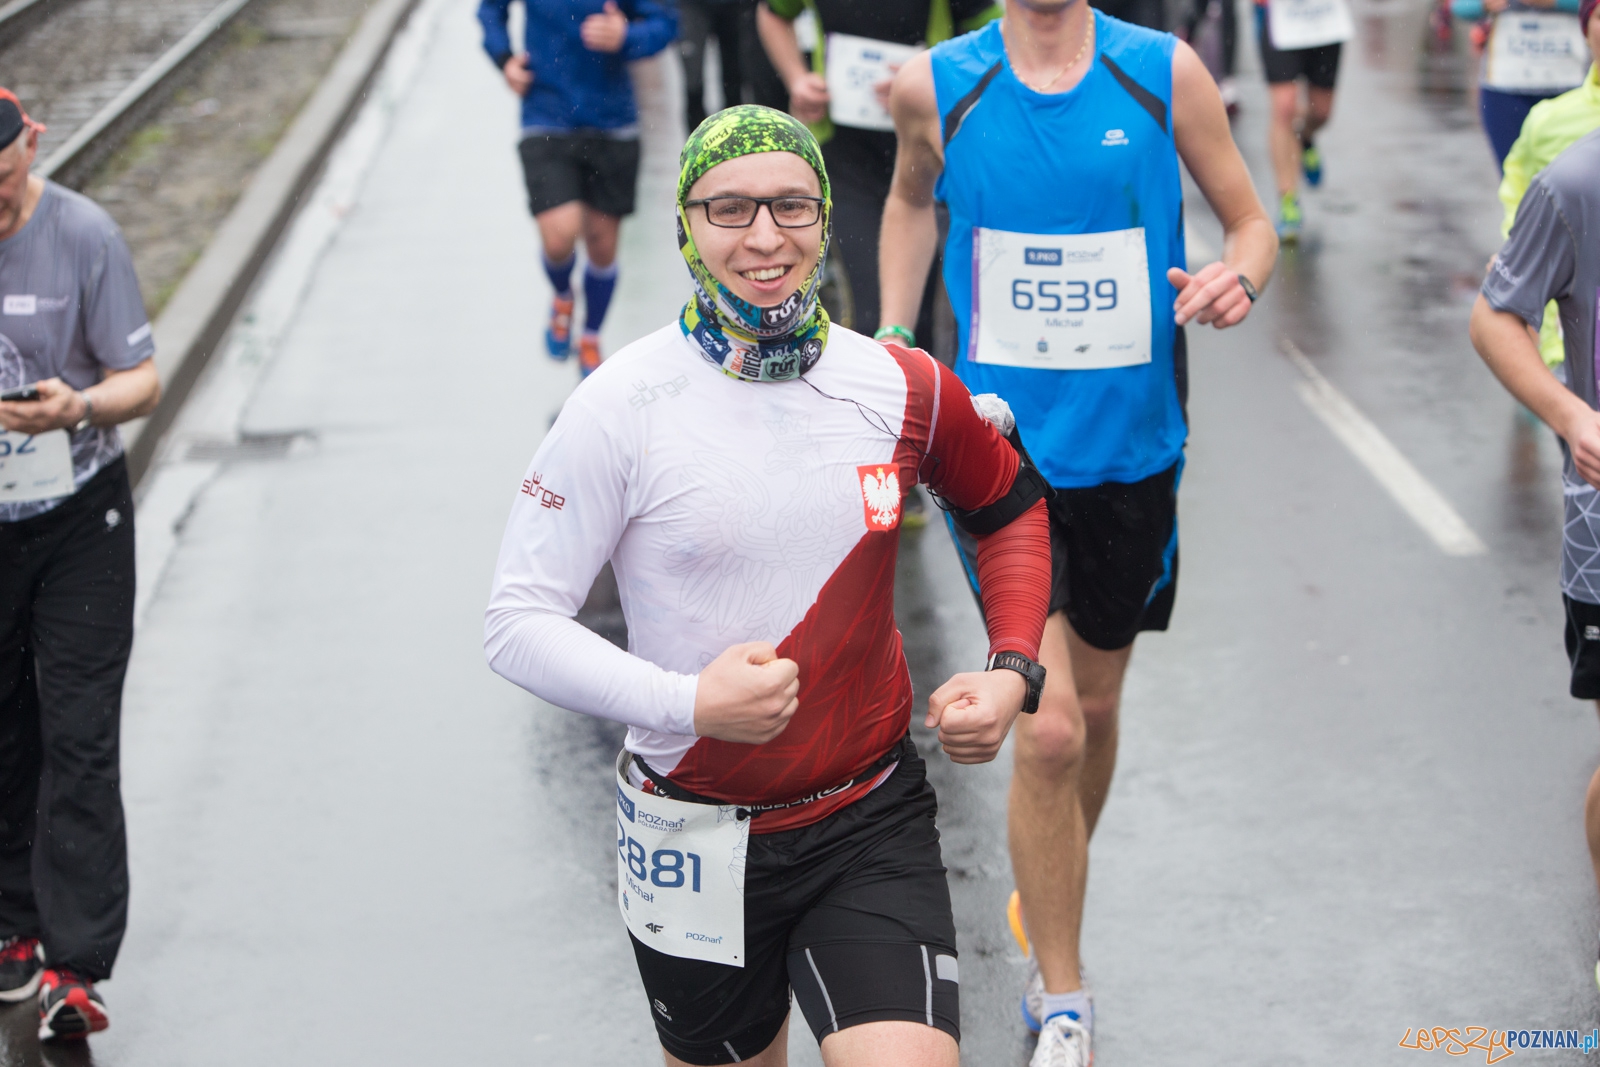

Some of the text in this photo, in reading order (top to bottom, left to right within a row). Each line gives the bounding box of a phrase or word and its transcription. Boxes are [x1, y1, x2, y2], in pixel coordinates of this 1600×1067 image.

[1027, 250, 1059, 263] 9.PKO
[1011, 278, 1118, 312] 6539
[628, 374, 691, 411] surge
[521, 474, 566, 511] surge
[617, 817, 702, 893] 2881
[625, 871, 655, 903] Michał
[645, 922, 664, 934] 4F
